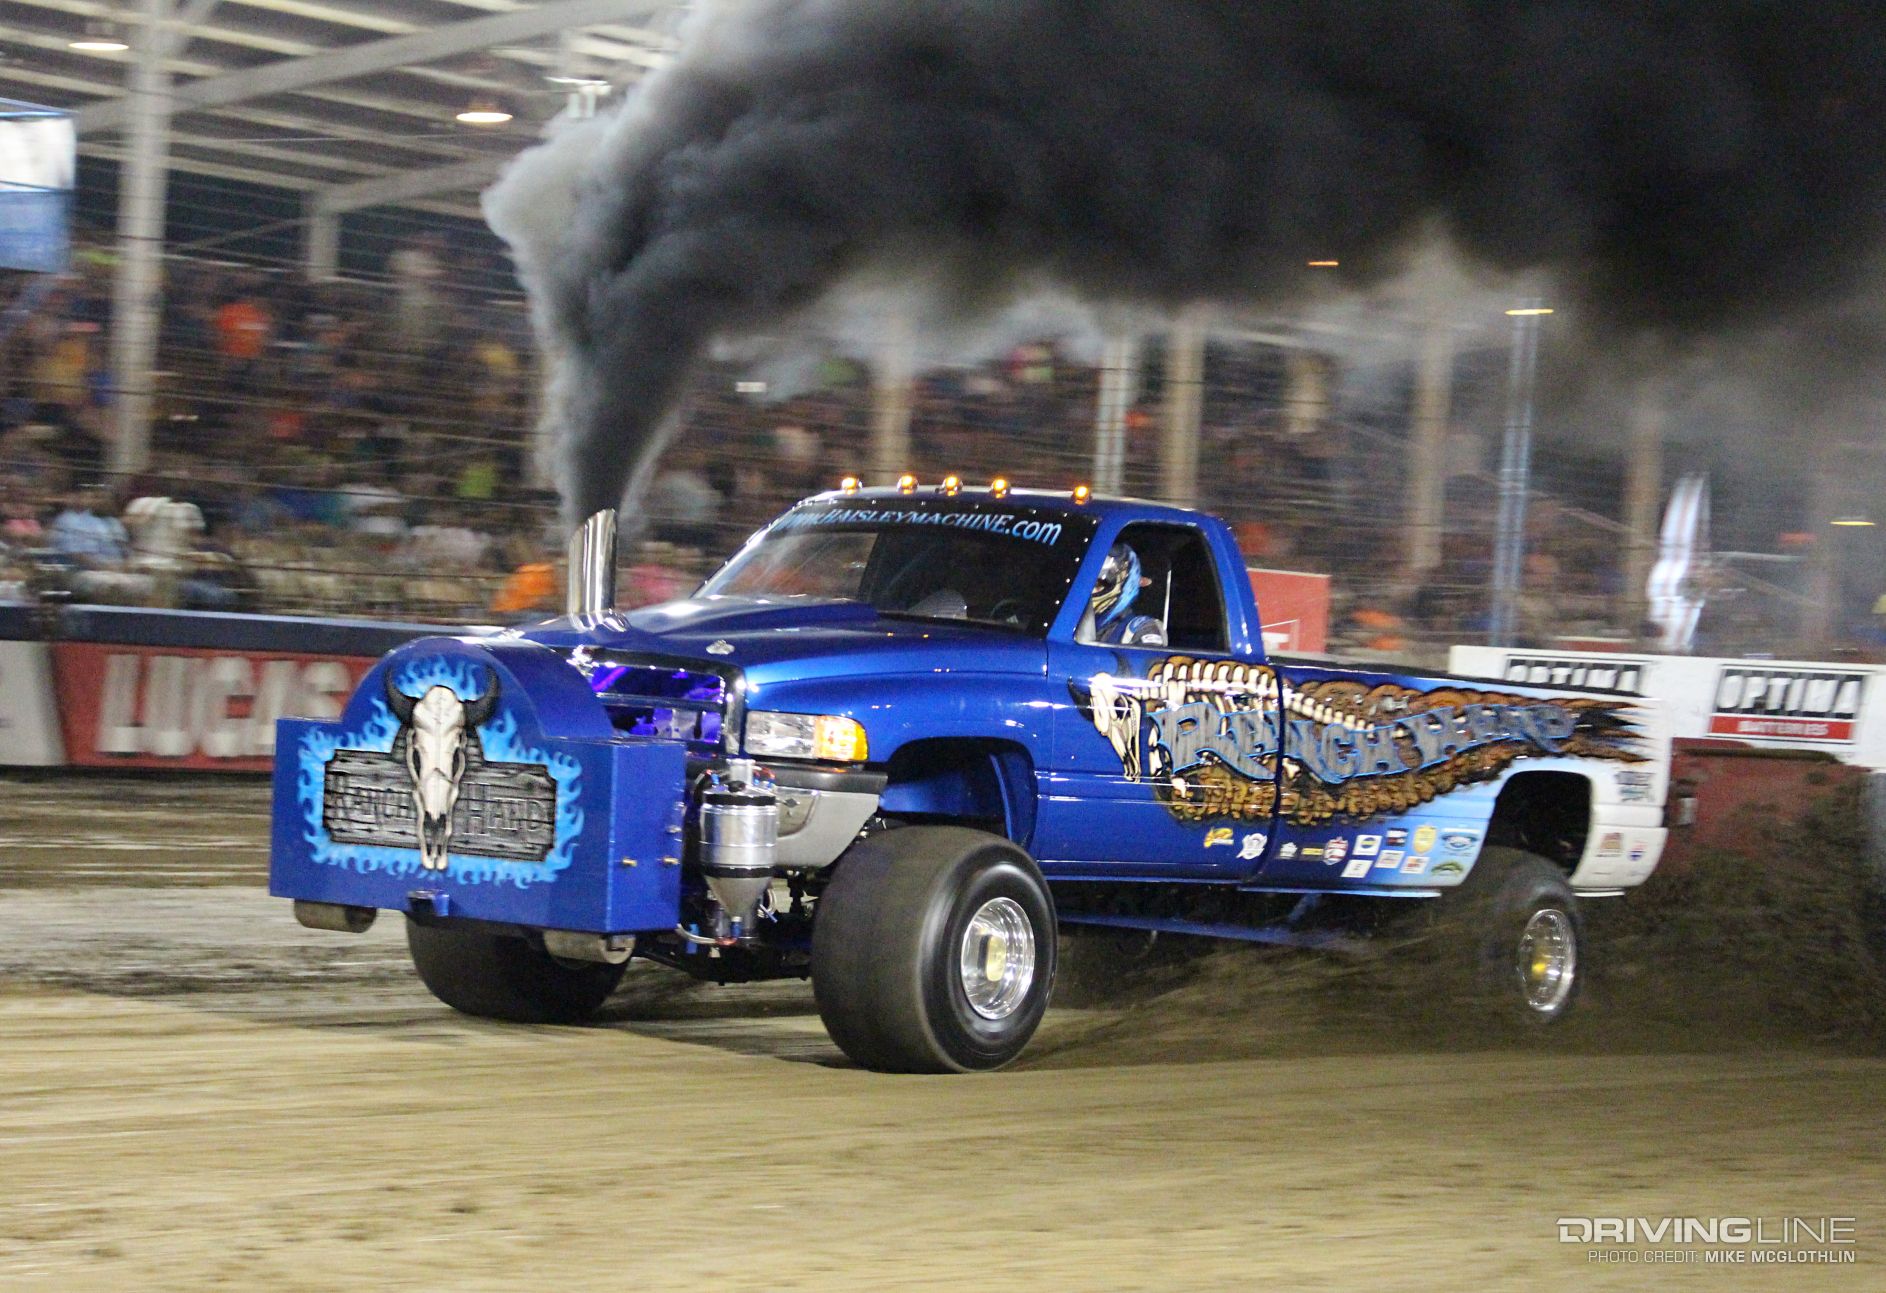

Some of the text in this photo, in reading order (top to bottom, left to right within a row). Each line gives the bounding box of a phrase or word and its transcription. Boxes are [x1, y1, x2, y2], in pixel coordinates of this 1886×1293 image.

[1506, 662, 1639, 693] OPTIMA
[1716, 672, 1862, 714] OPTIMA
[1738, 718, 1829, 737] BATTERIES
